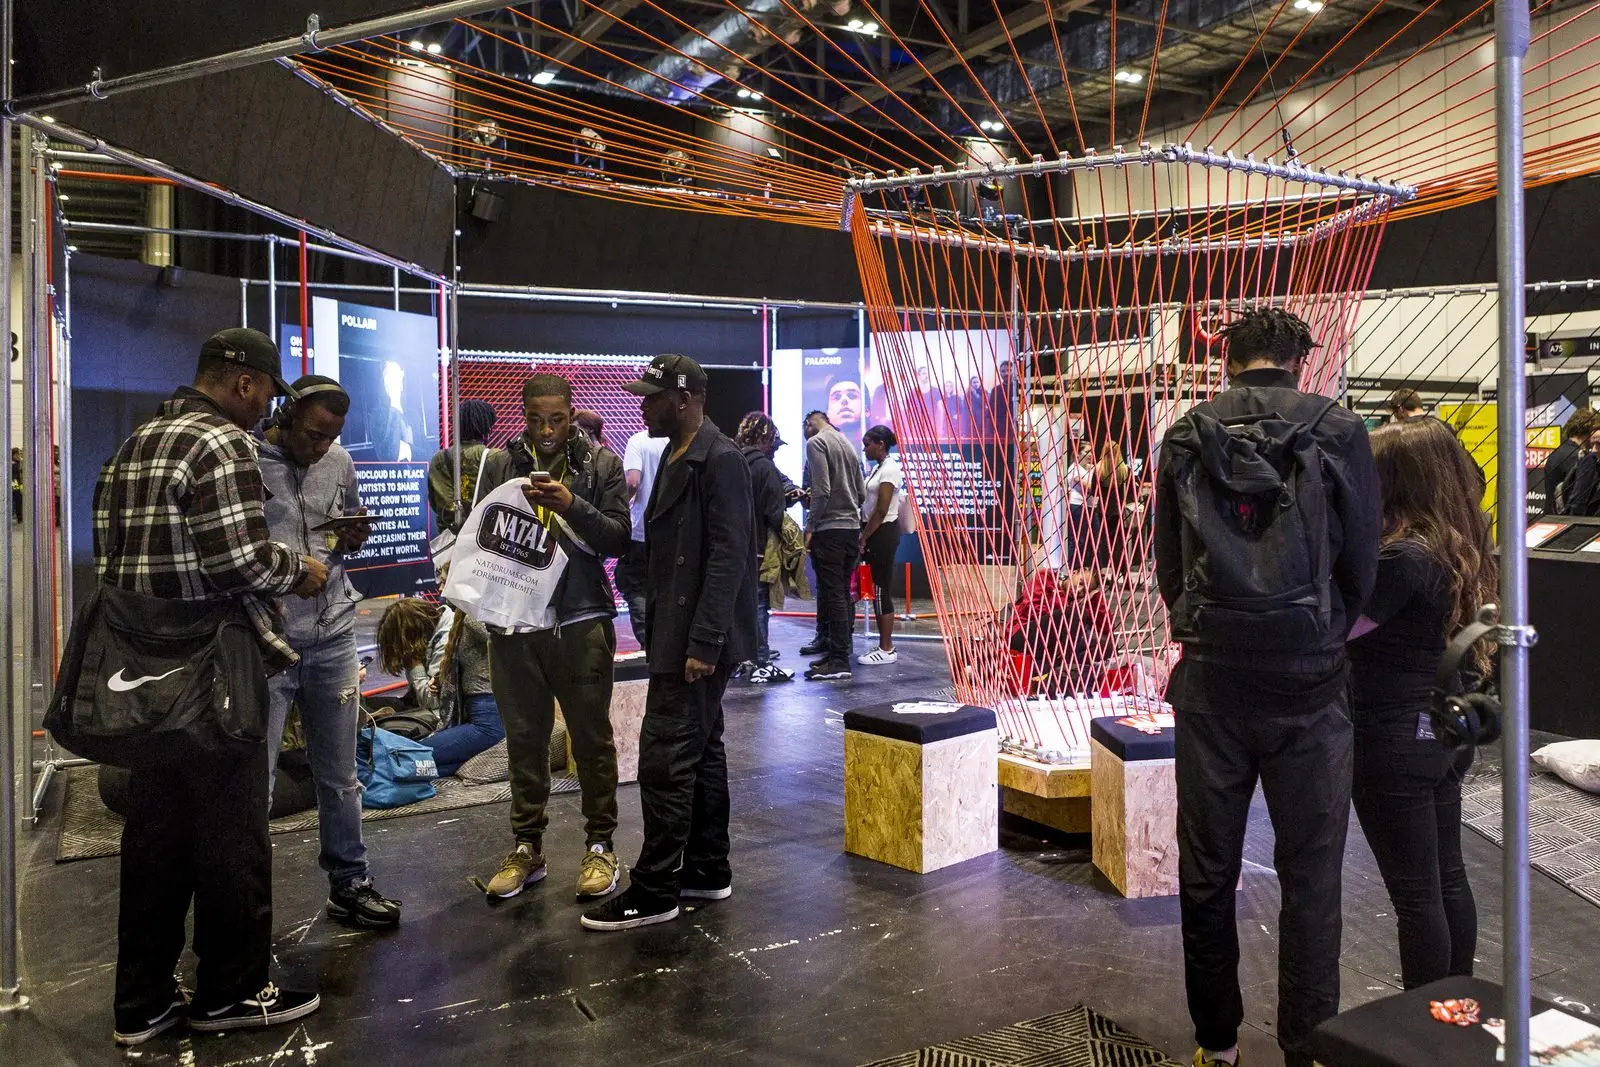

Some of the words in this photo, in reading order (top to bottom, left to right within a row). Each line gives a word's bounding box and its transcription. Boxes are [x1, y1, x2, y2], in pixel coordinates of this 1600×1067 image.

[1525, 430, 1555, 446] OVE
[389, 470, 397, 479] IS
[396, 470, 403, 479] A
[403, 468, 425, 479] PLACE
[358, 483, 386, 493] ARTISTS
[387, 482, 396, 492] TO
[396, 481, 420, 492] SHARE
[380, 495, 401, 506] GROW
[401, 494, 421, 504] THEIR
[380, 508, 394, 518] AND
[394, 507, 420, 517] CREATE
[397, 520, 411, 530] ALL
[407, 530, 427, 541] THEIR
[491, 510, 548, 554] NATAL
[380, 546, 394, 557] NET
[395, 544, 421, 555] WORTH.
[512, 546, 529, 559] 1965
[415, 768, 439, 777] SILVER
